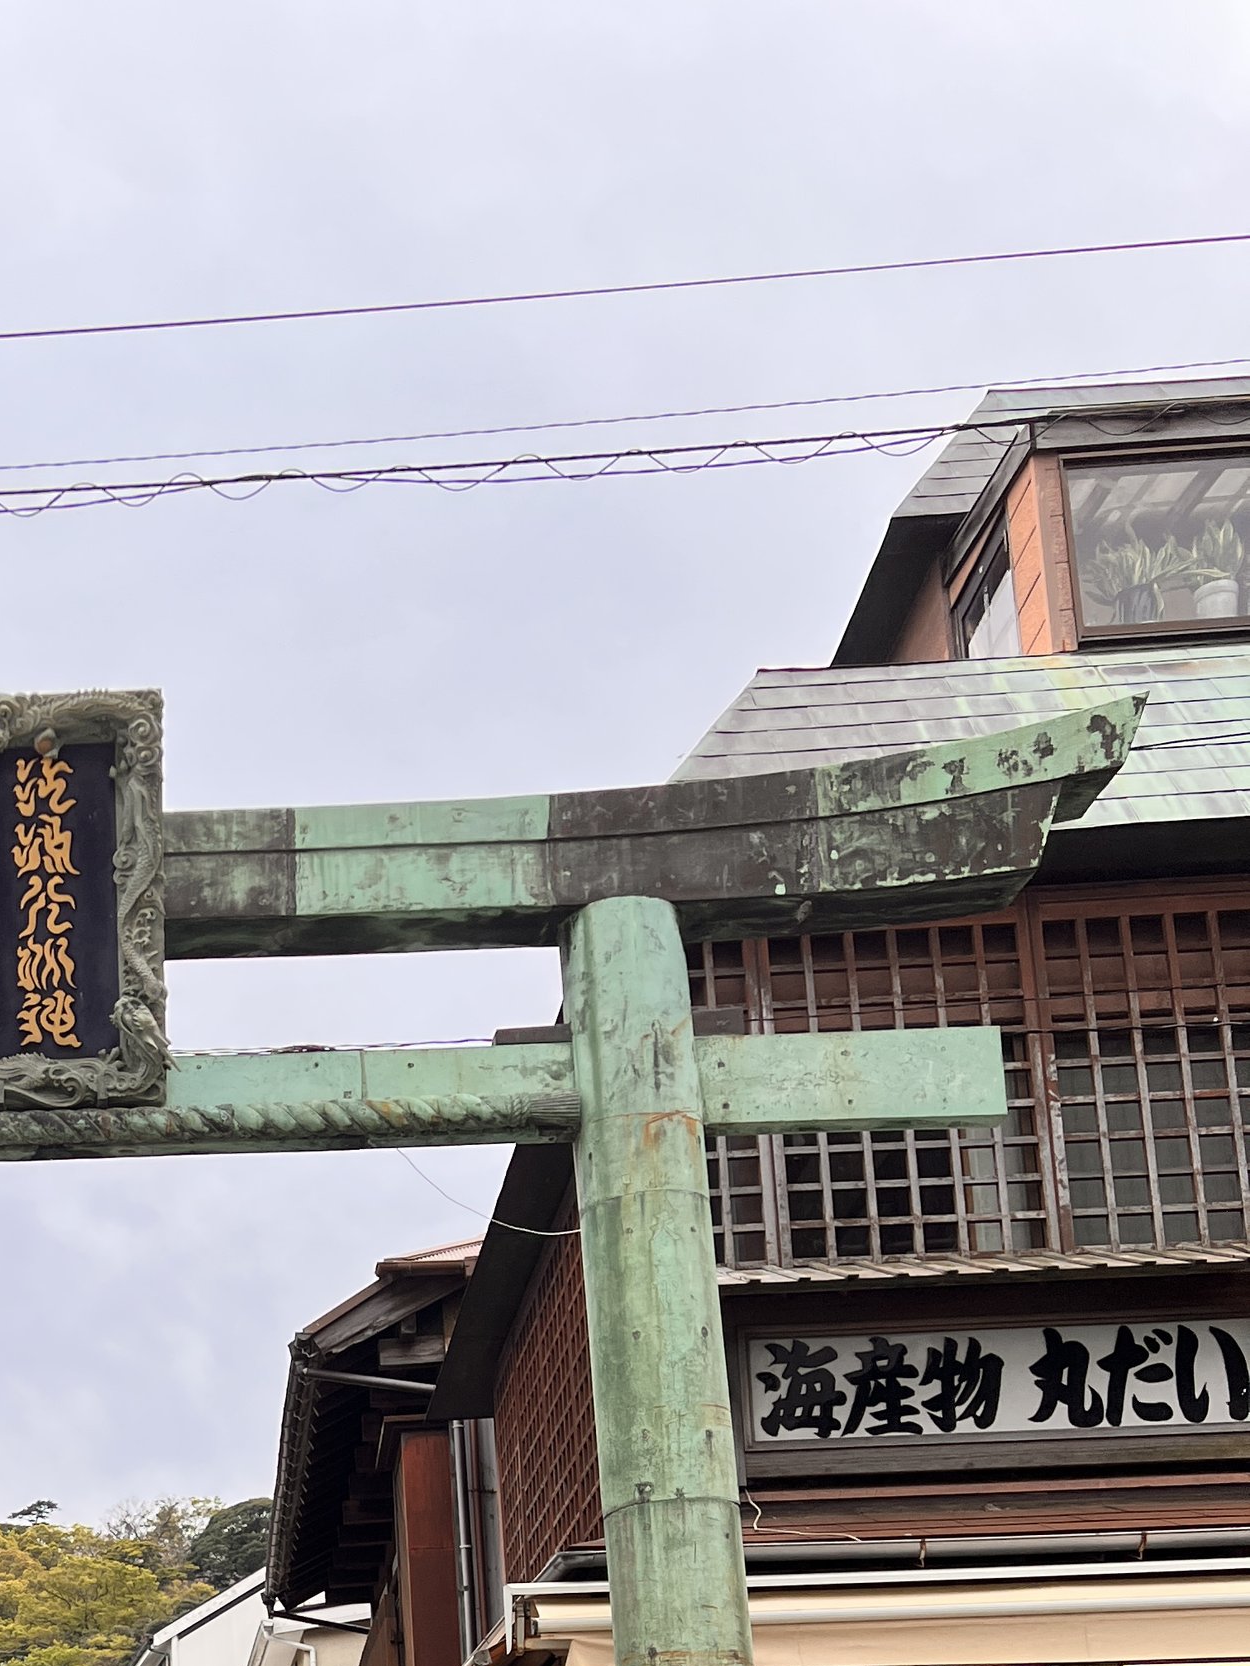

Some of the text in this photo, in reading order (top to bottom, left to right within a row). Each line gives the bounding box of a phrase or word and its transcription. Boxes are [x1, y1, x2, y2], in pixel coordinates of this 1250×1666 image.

[756, 1324, 1250, 1438] 海産物 丸だい
